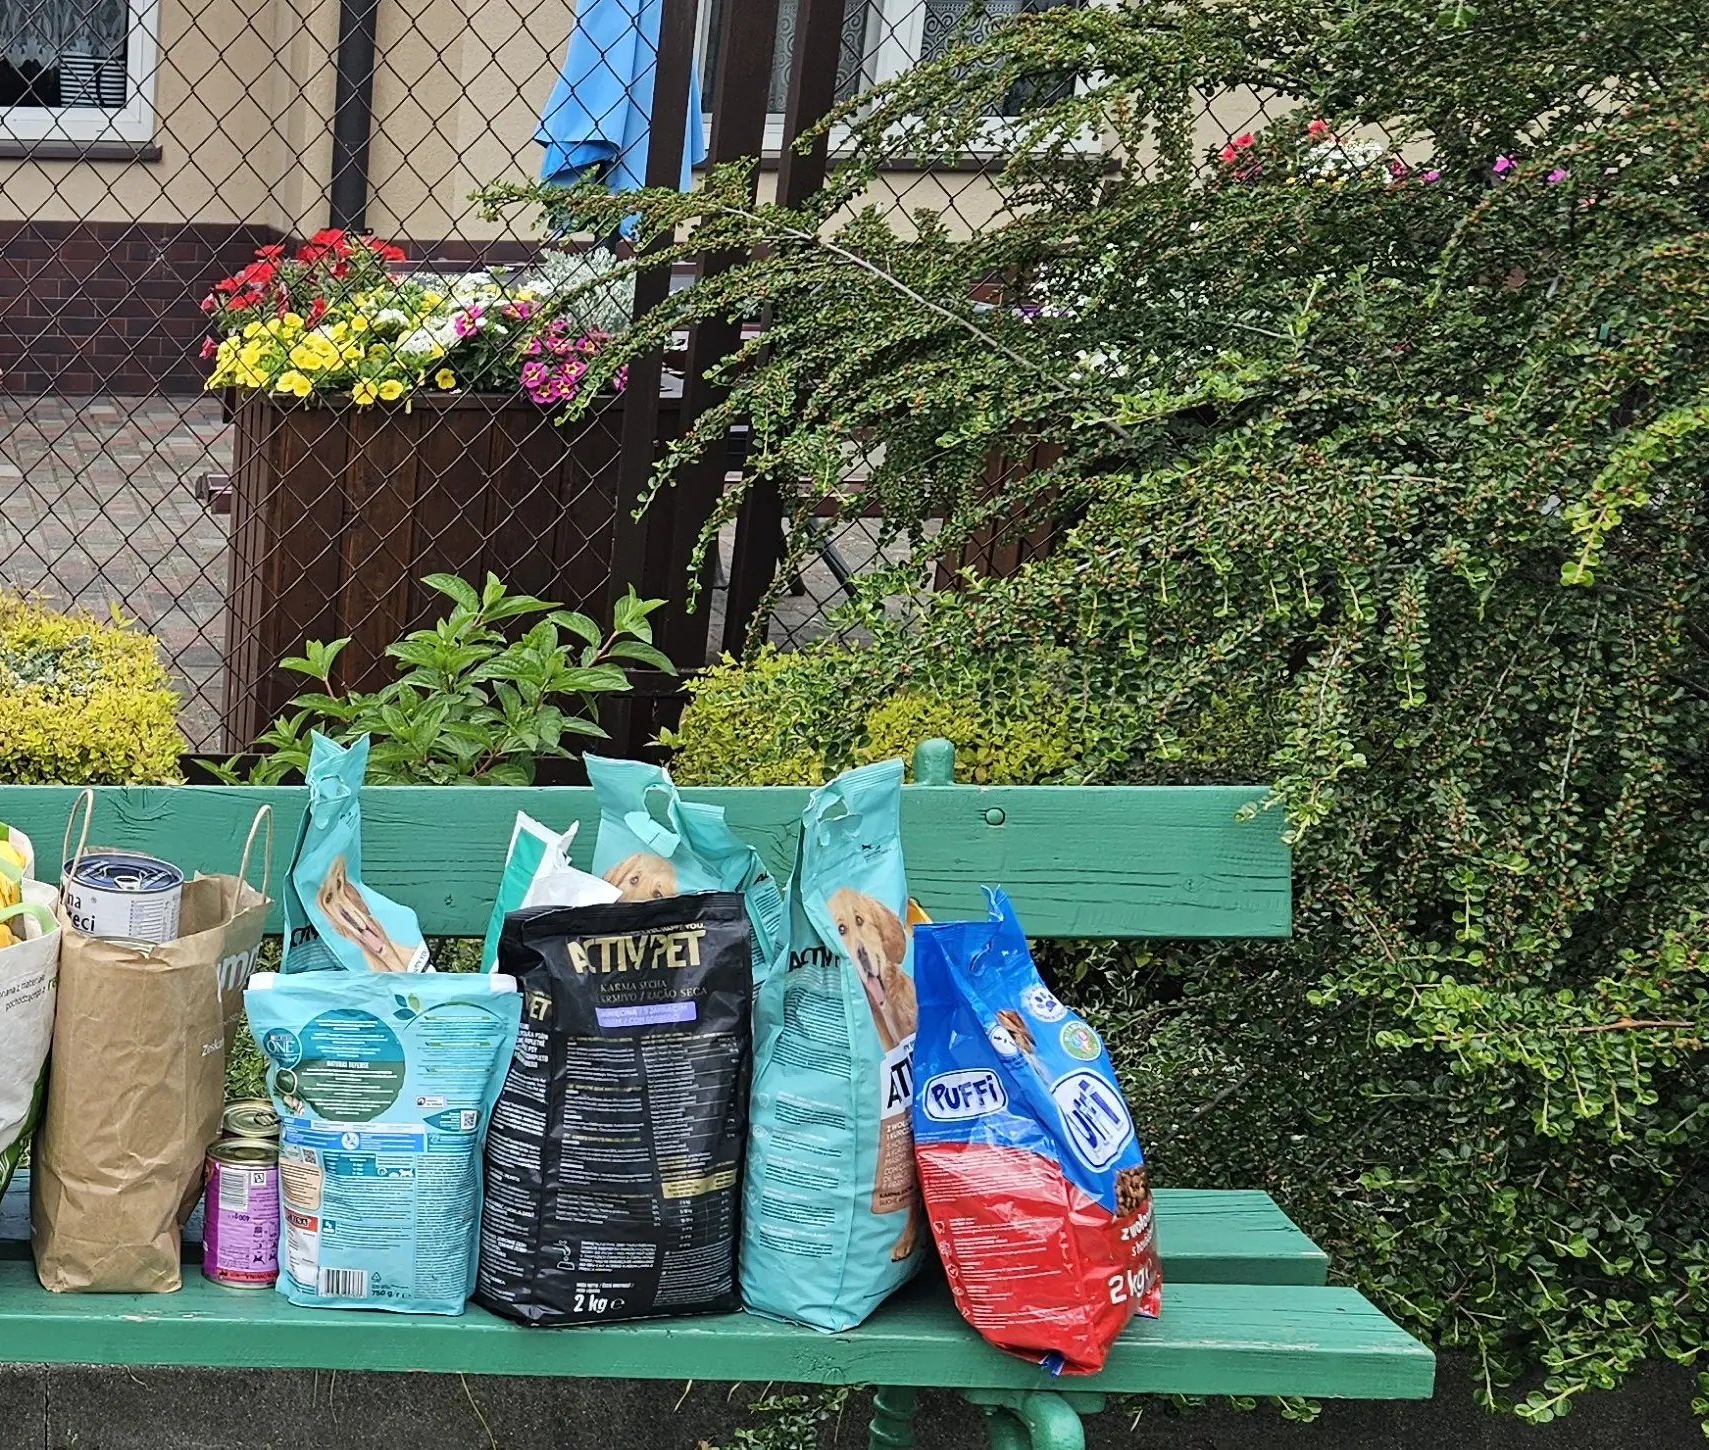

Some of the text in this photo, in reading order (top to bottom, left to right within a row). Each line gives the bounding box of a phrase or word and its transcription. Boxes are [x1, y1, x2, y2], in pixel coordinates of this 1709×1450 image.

[600, 982, 637, 993] KARMA
[681, 987, 707, 997] SECA
[266, 1040, 296, 1053] ONE
[1109, 1276, 1127, 1305] 2
[573, 1294, 585, 1312] 2
[588, 1294, 609, 1313] kg
